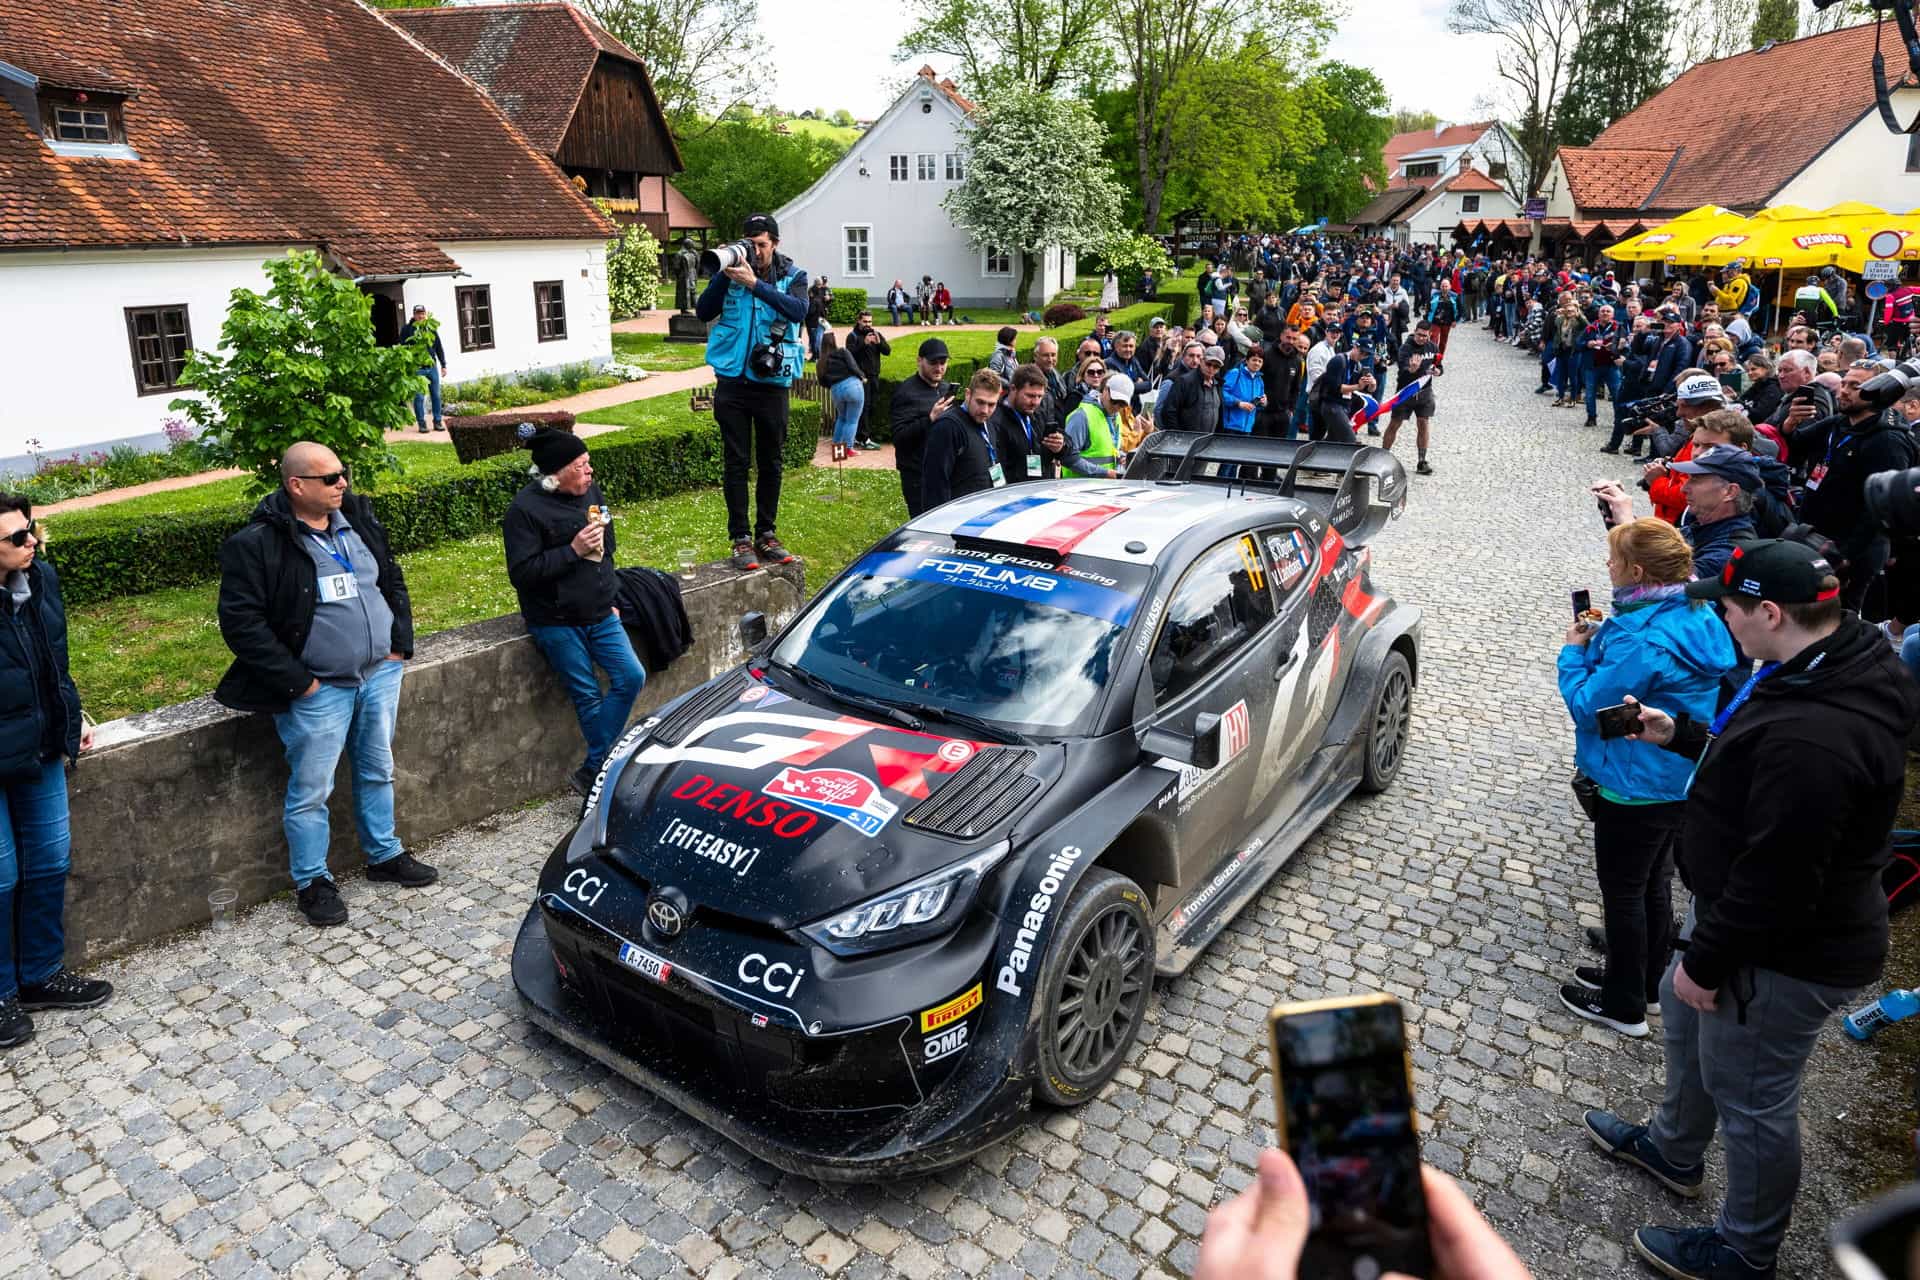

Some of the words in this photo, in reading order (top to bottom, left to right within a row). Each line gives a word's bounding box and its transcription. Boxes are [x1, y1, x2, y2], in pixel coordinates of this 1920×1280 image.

[917, 558, 1059, 592] FORUM8
[929, 545, 990, 561] TOYOTA
[986, 553, 1055, 571] GAZOO
[1056, 565, 1118, 587] Racing
[671, 773, 820, 840] DENSO
[996, 844, 1082, 998] Panasonic
[627, 950, 660, 976] A-7450
[924, 1025, 969, 1058] OMP
